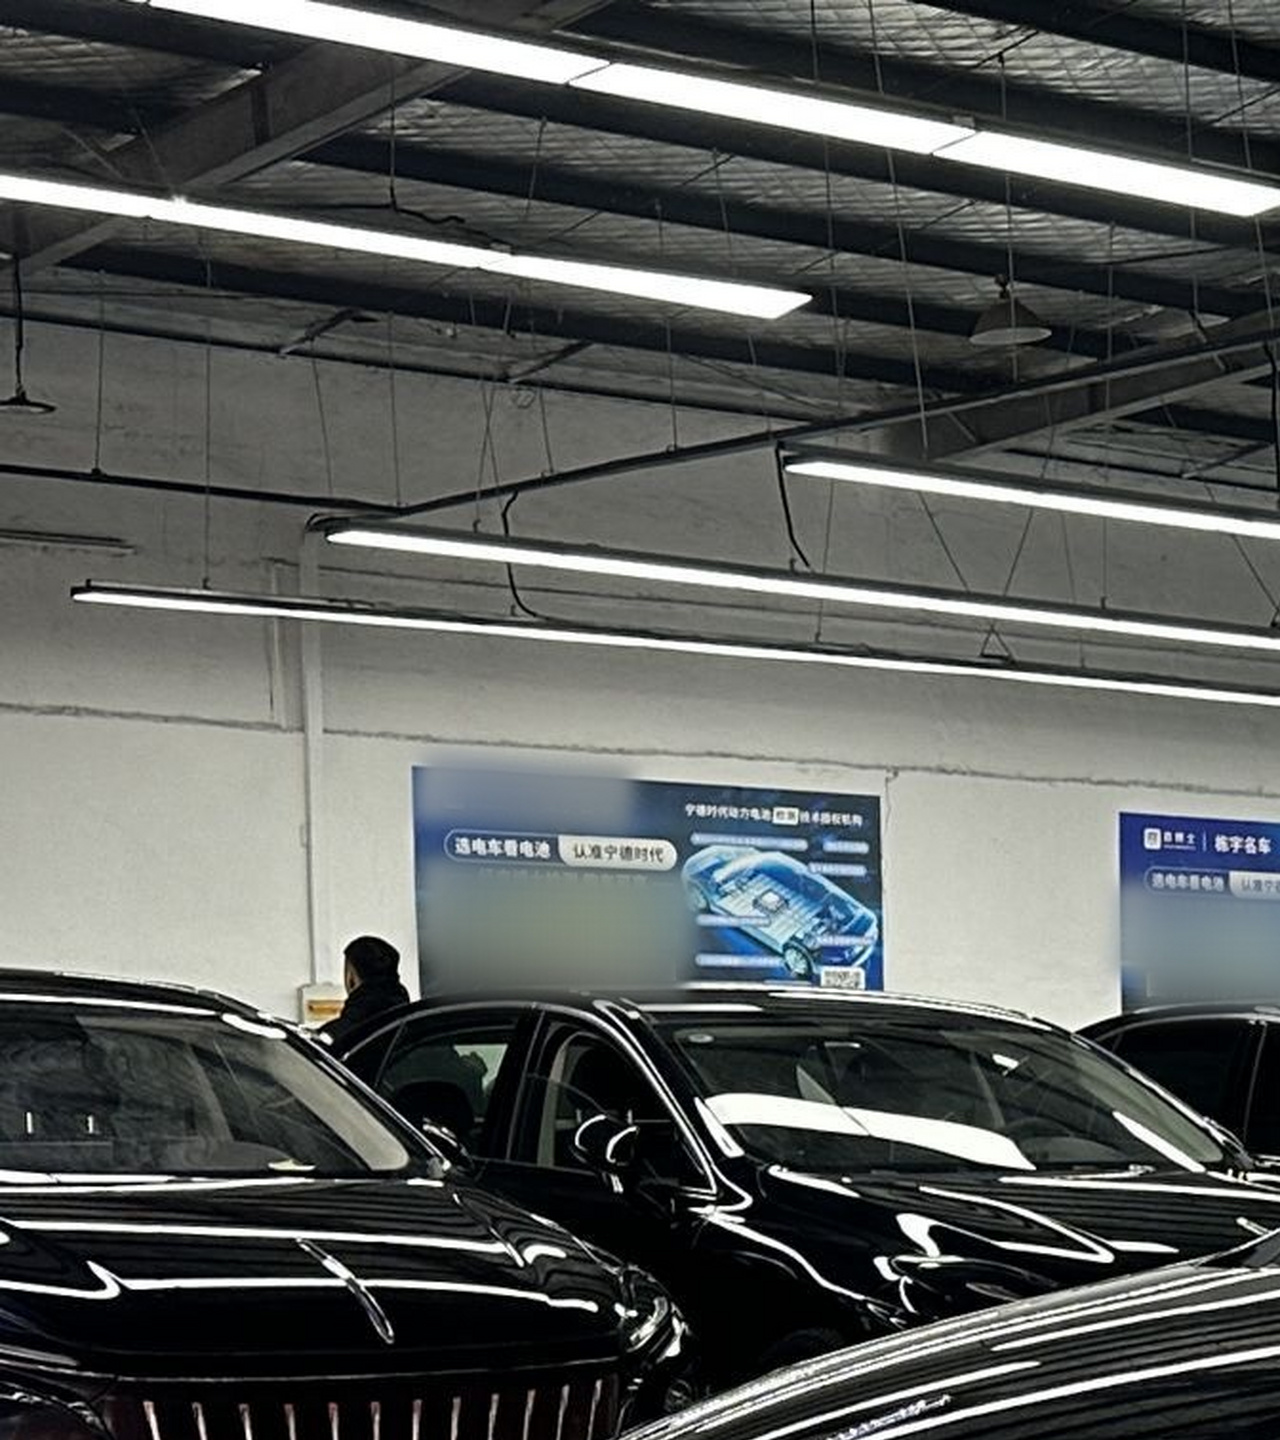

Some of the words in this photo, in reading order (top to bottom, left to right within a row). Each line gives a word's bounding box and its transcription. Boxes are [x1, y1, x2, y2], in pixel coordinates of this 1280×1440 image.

[573, 843, 665, 863] 认准宁德时代
